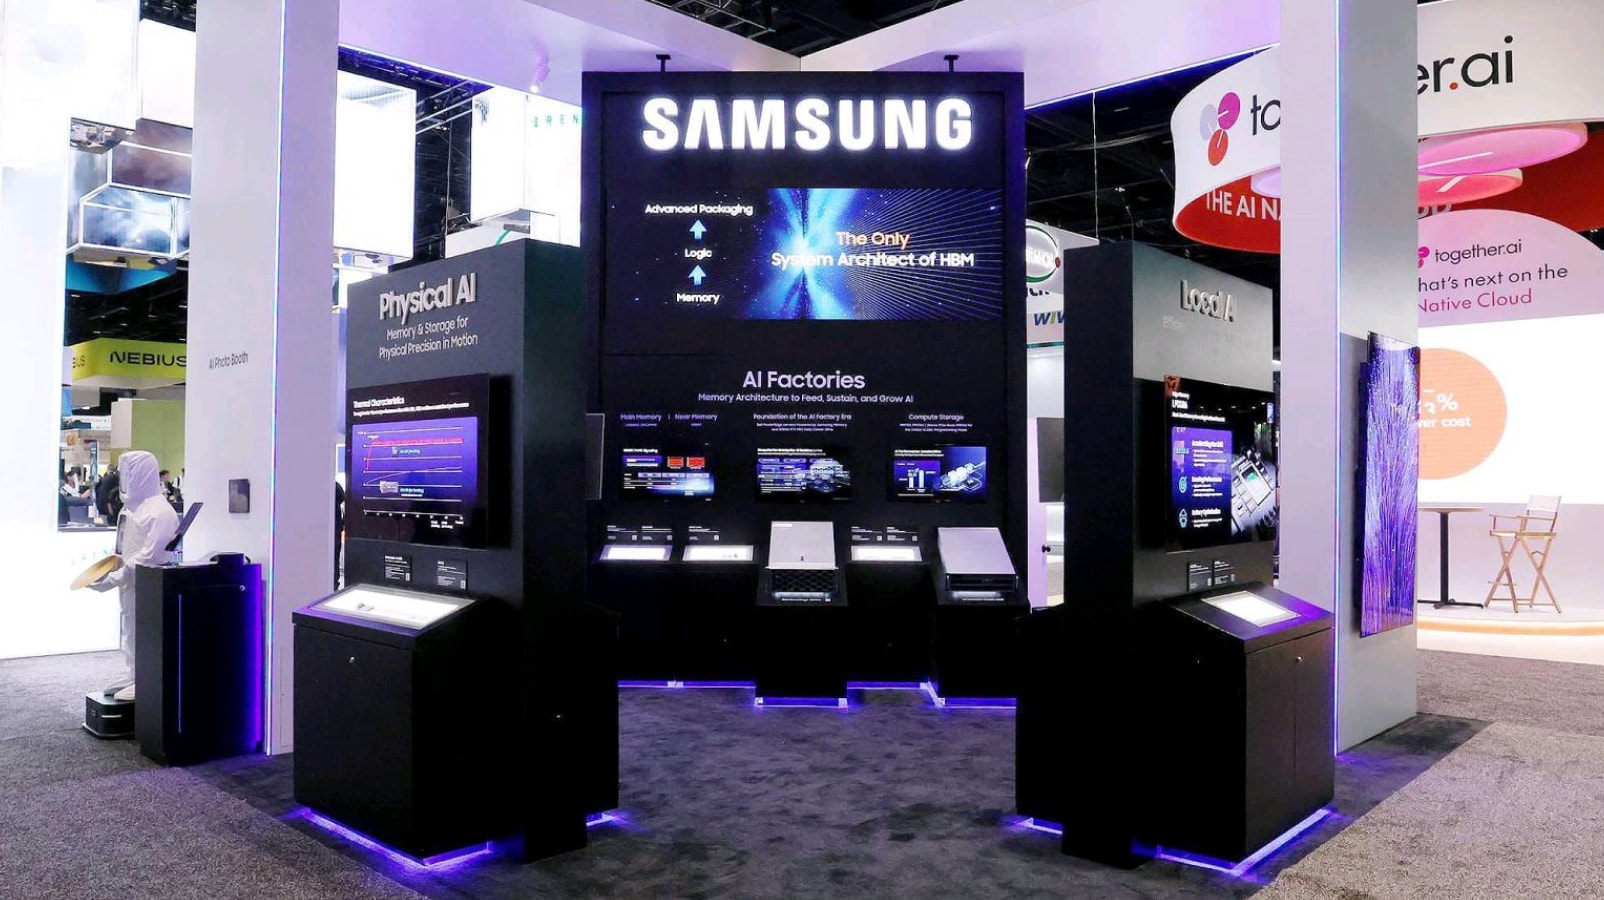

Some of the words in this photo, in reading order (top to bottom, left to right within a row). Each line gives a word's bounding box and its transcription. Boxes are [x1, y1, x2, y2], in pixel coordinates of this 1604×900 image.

[641, 97, 973, 152] SAMSUNG
[644, 204, 698, 215] Advanced
[699, 204, 754, 217] Packaging
[1236, 195, 1256, 219] AI
[1261, 196, 1282, 221] N
[836, 231, 867, 246] The
[871, 231, 910, 249] Only
[684, 247, 713, 260] Logic
[771, 252, 834, 271] System
[838, 252, 915, 268] Architect
[917, 252, 937, 267] of
[939, 252, 975, 268] HBM
[1435, 238, 1522, 266] together.ai
[1418, 276, 1459, 292] hat's
[1464, 271, 1503, 288] next
[1508, 271, 1531, 284] on
[1538, 263, 1569, 280] the
[379, 277, 453, 325] Physical
[455, 272, 478, 306] AI
[676, 292, 720, 305] Memory
[1181, 279, 1225, 320] Local
[1477, 287, 1533, 308] Cloud
[386, 325, 417, 341] Memory
[417, 322, 424, 336] &
[425, 317, 456, 335] Storage
[456, 314, 470, 330] for
[379, 342, 408, 361] Physical
[408, 337, 442, 355] Precision
[442, 336, 450, 350] in
[450, 333, 479, 348] Motion
[110, 351, 188, 367] NEBIUS
[208, 358, 215, 370] AI
[215, 355, 231, 369] Photo
[231, 351, 249, 367] Booth
[743, 370, 762, 388] AI
[767, 369, 866, 389] Factories
[698, 393, 735, 404] Memory
[735, 393, 790, 402] Architecture
[791, 394, 800, 402] to
[801, 394, 825, 403] Feed,
[826, 394, 859, 403] Sustain,
[860, 394, 878, 403] and
[879, 394, 904, 403] Grow
[905, 394, 914, 403] AI
[636, 413, 662, 422] Memory
[691, 413, 718, 422] Memory
[816, 413, 840, 422] Factory
[908, 413, 938, 422] Compute
[939, 413, 965, 422] Storage
[1441, 416, 1472, 428] cost
